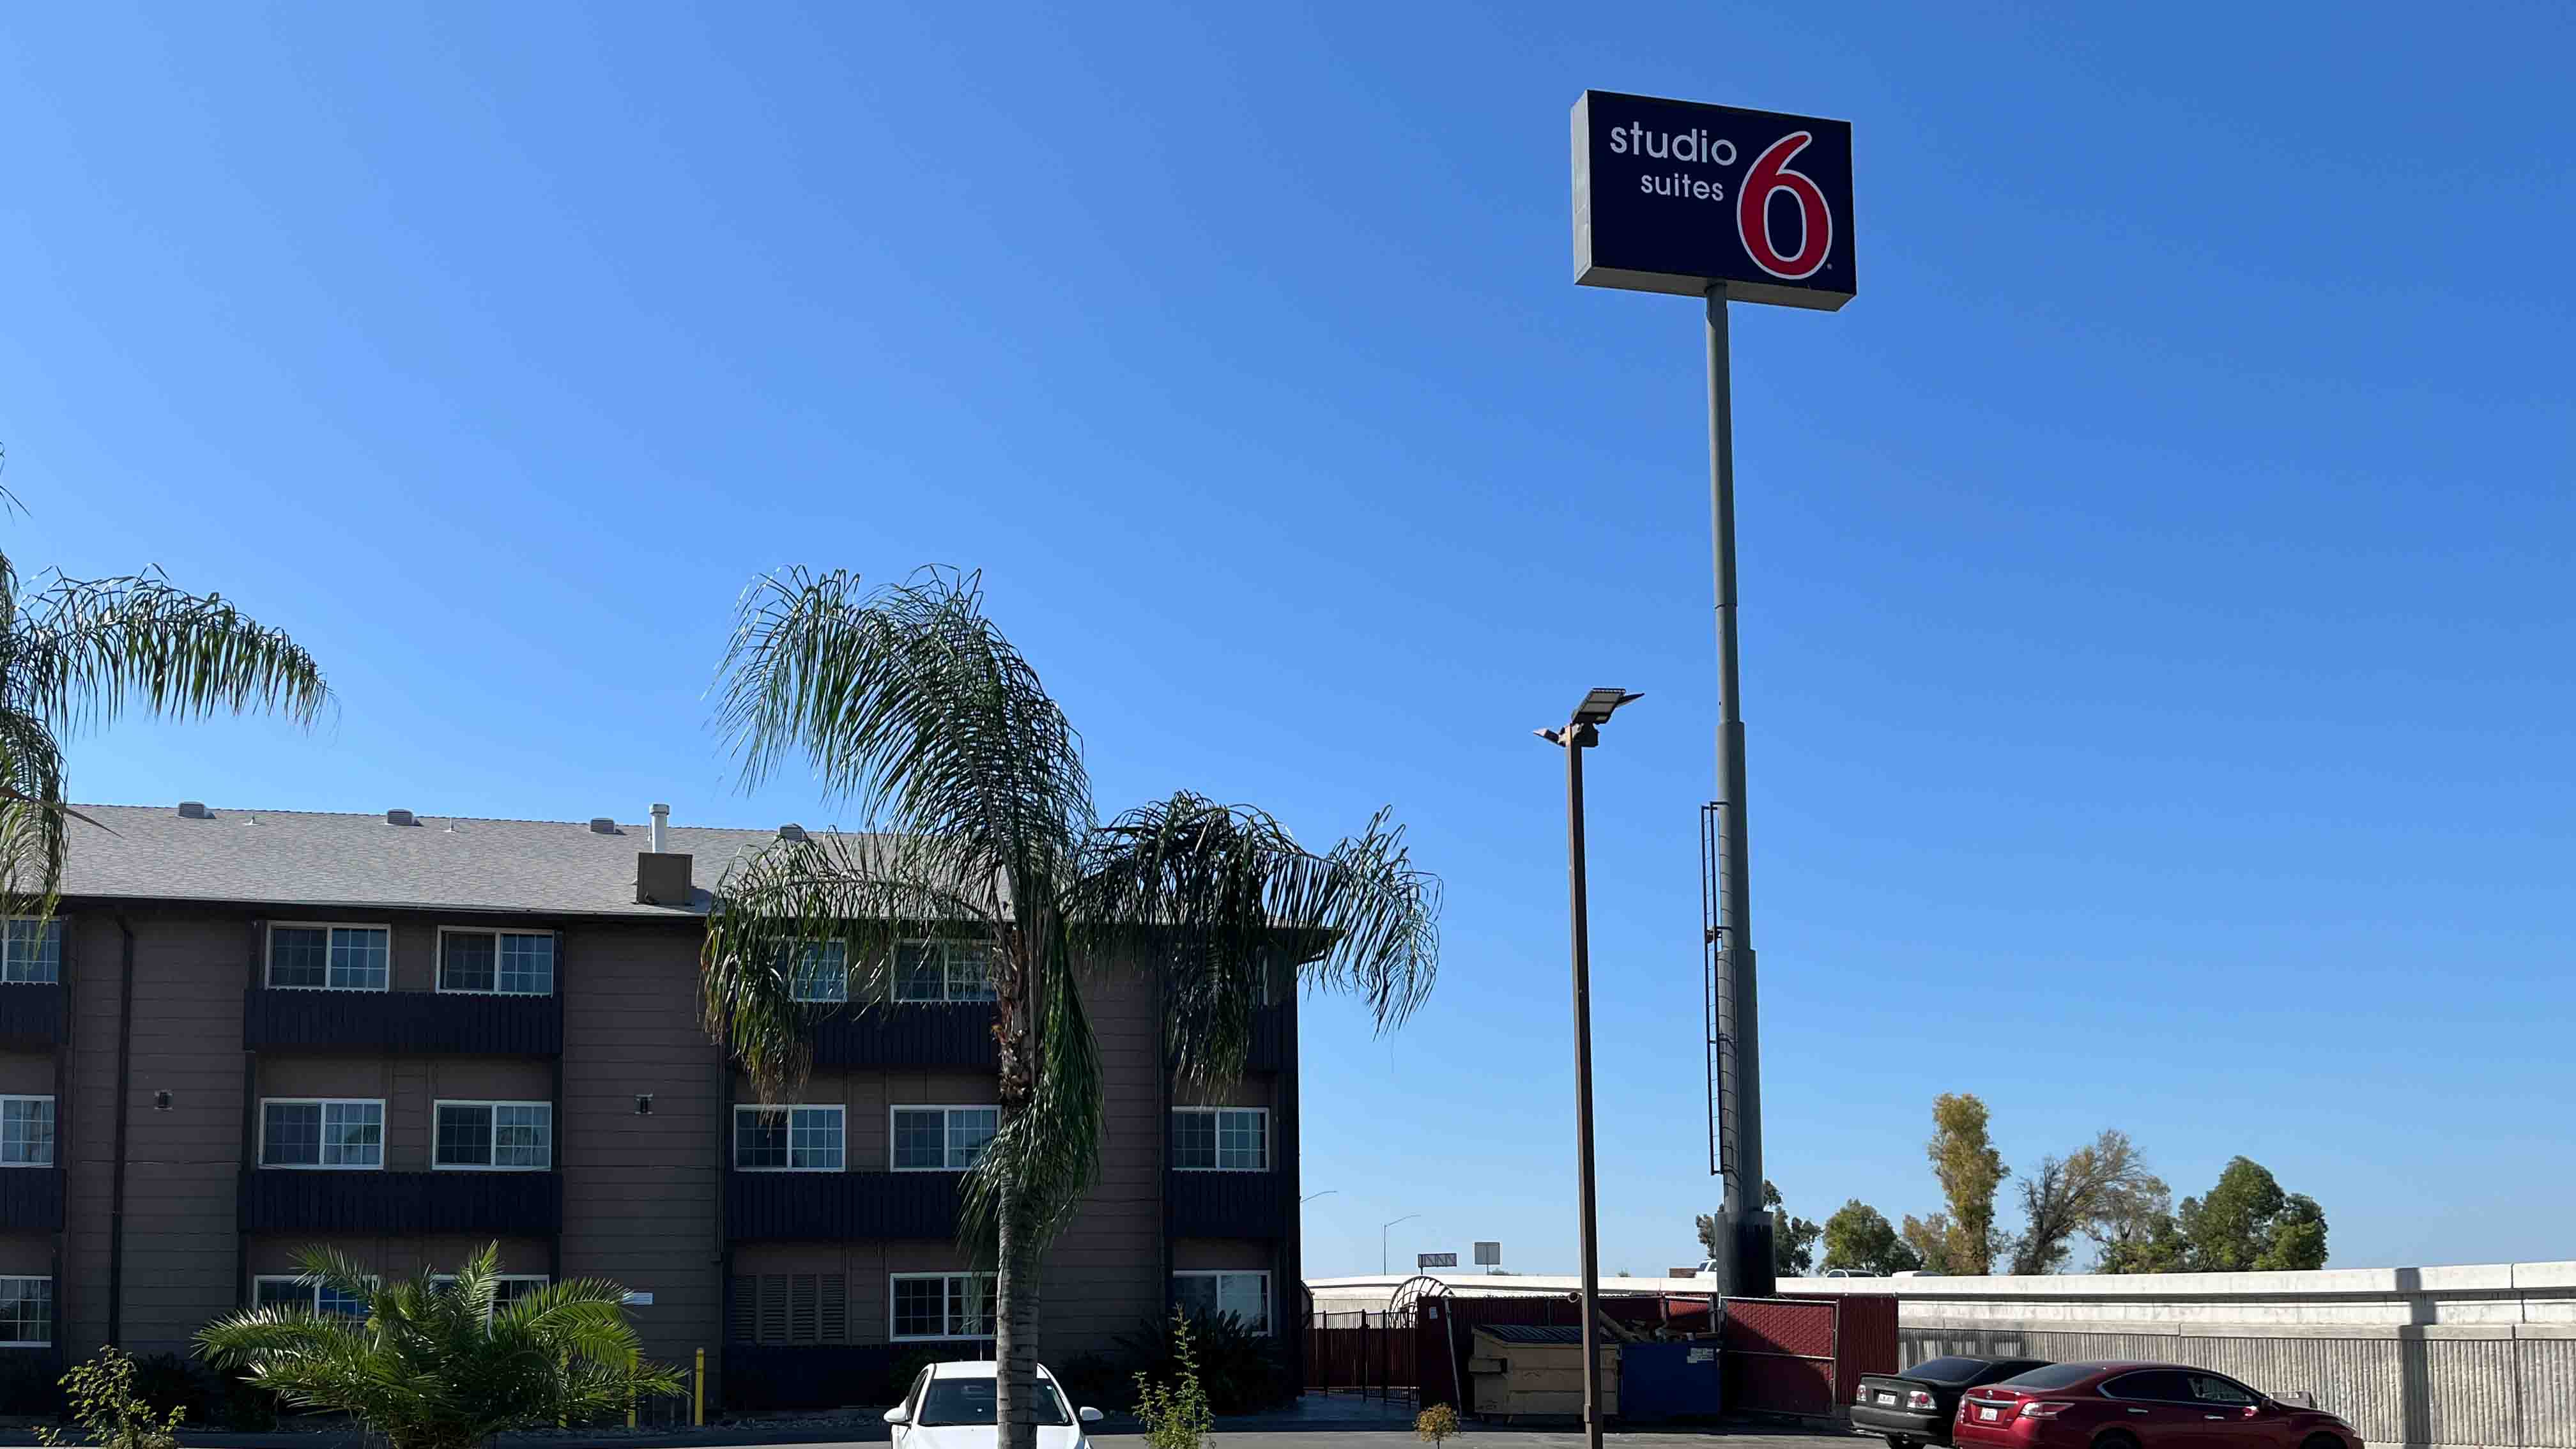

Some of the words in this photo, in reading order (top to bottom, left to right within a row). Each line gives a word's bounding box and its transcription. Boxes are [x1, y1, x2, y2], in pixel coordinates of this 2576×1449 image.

[1610, 121, 1737, 166] studio
[1641, 173, 1724, 201] suites
[1736, 130, 1833, 280] 6
